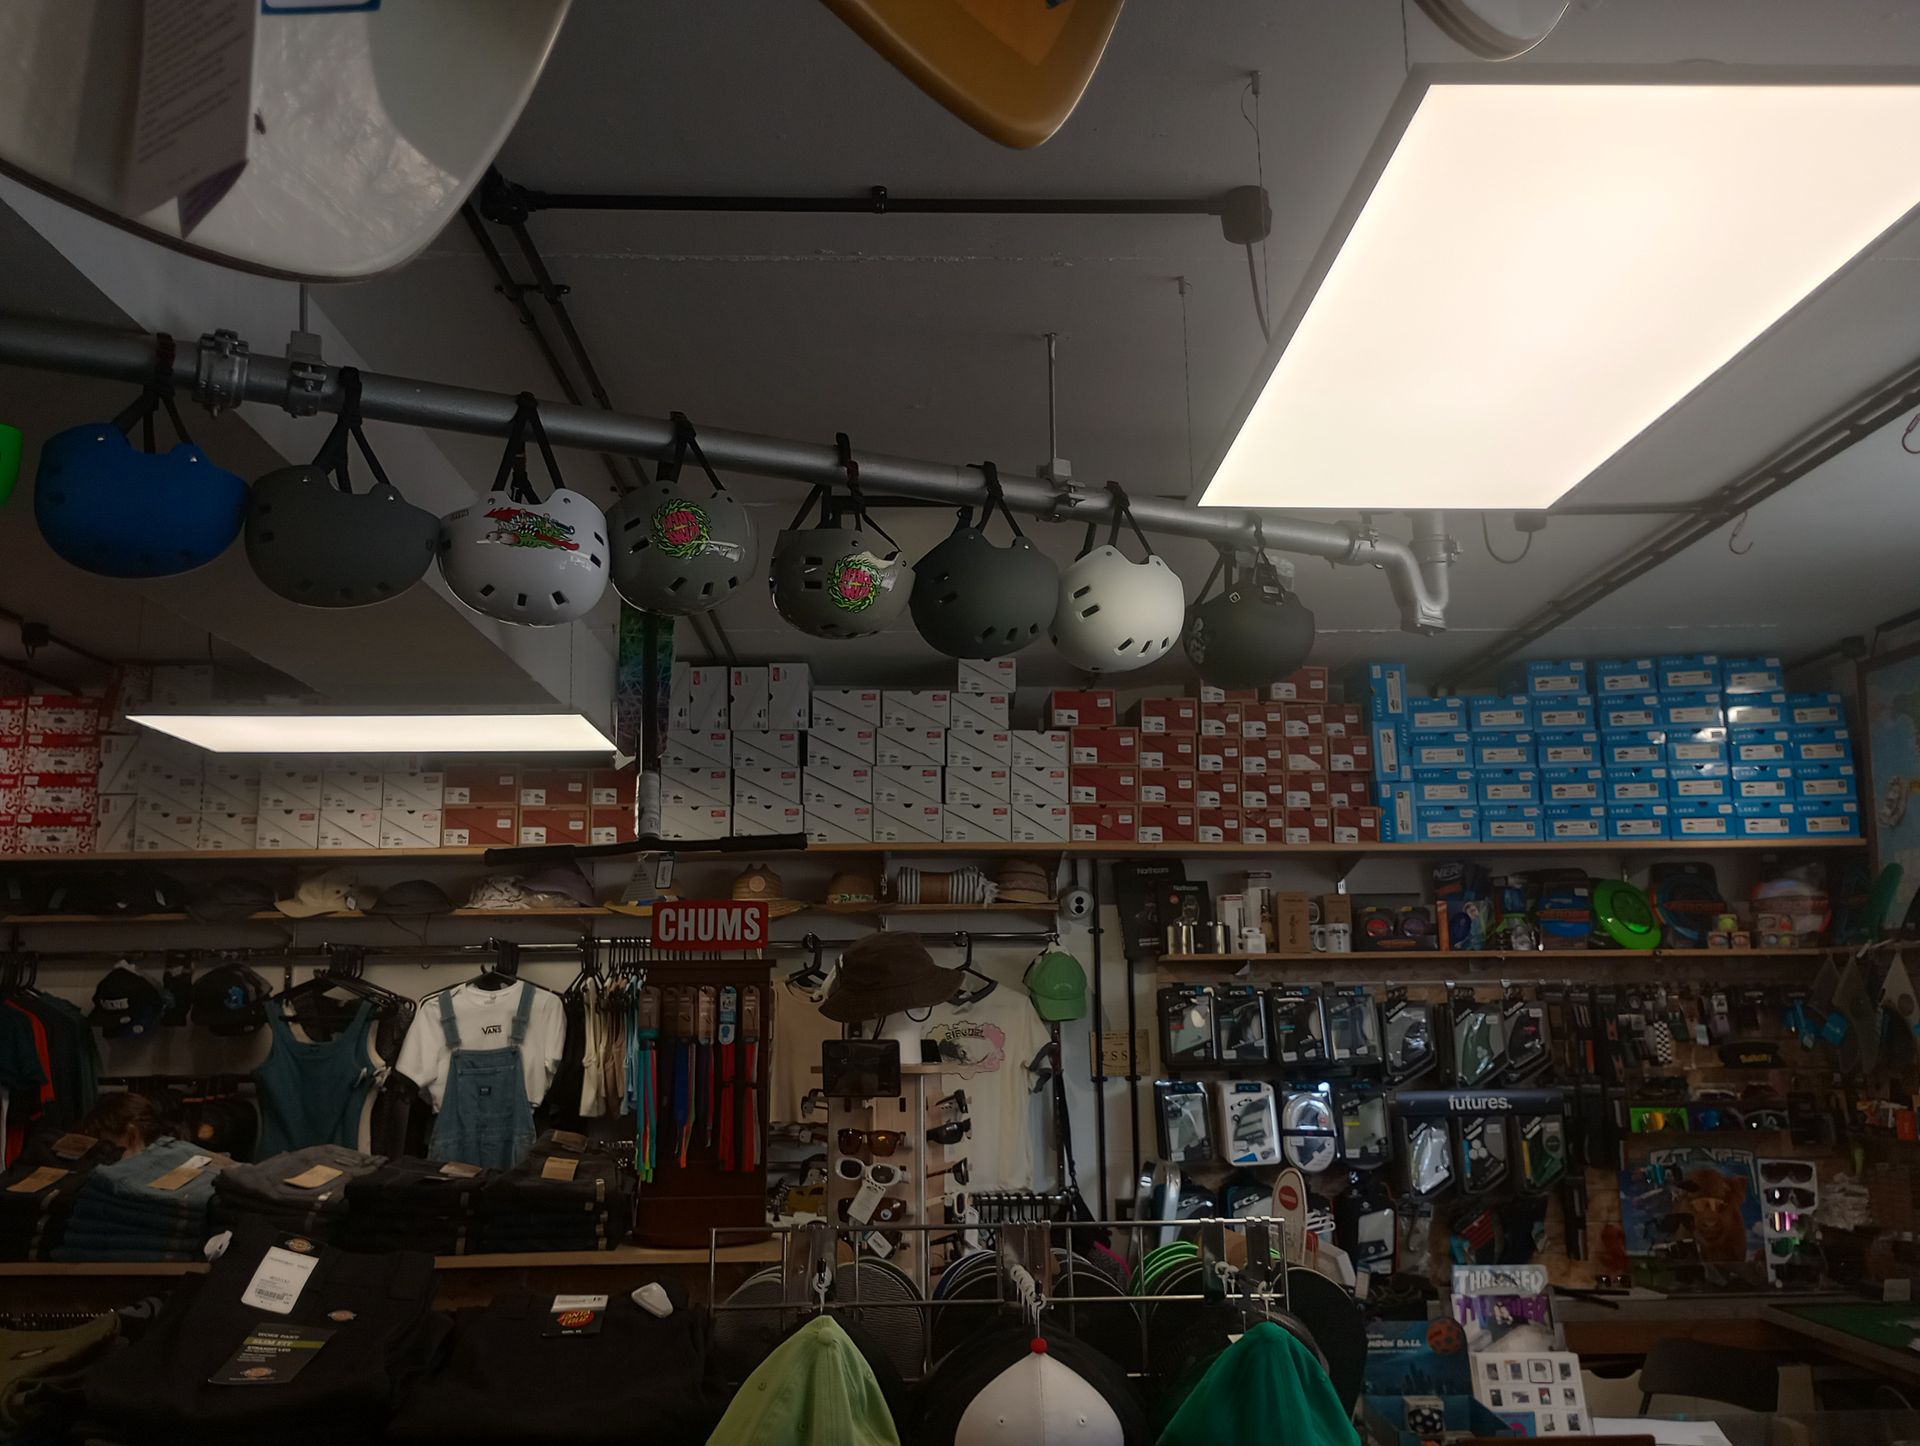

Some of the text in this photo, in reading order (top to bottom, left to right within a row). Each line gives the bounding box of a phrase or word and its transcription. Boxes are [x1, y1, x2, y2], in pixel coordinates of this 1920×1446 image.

[658, 906, 762, 942] CHUMS
[481, 1024, 502, 1035] VANS
[1448, 1094, 1513, 1111] futures.
[1397, 1338, 1422, 1347] BALL
